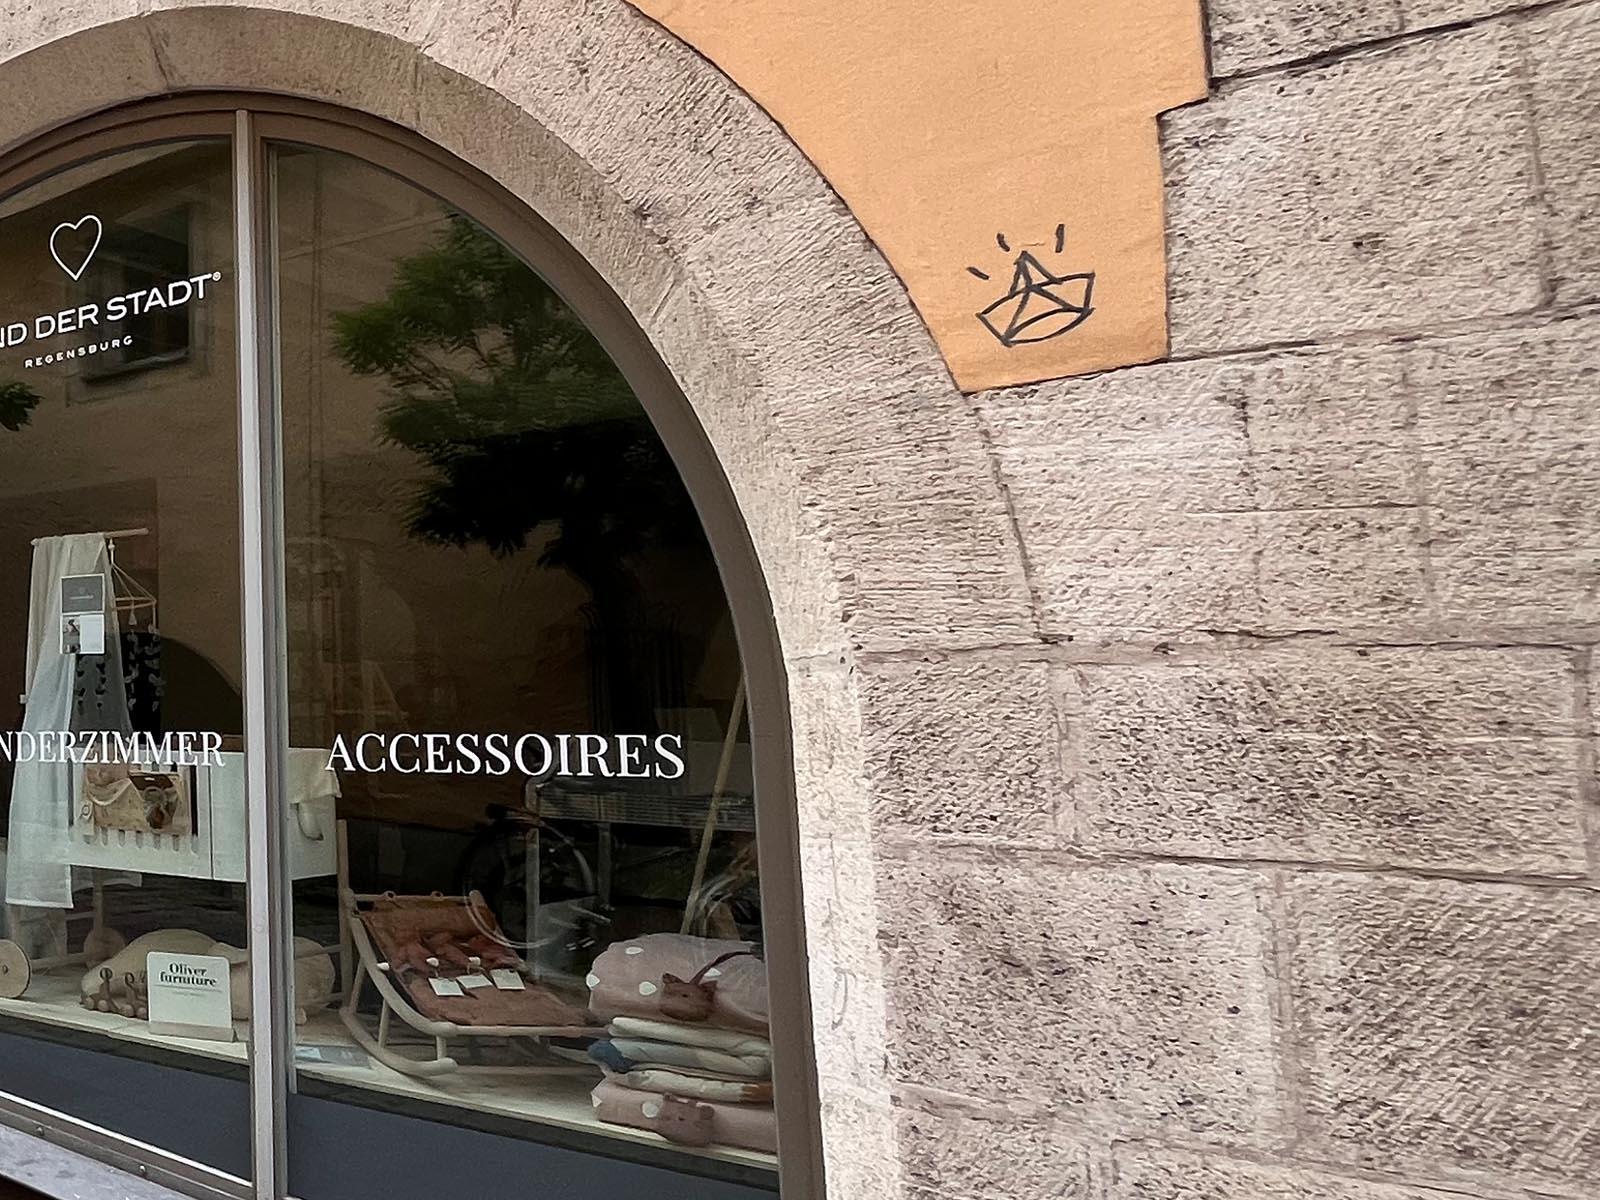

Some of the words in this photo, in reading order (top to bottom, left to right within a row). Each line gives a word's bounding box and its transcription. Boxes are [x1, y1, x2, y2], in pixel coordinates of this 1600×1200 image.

[35, 303, 99, 339] DER
[24, 335, 134, 369] REGENSBURG
[324, 732, 686, 780] ACCESSOIRES
[160, 971, 217, 987] furniture
[169, 962, 208, 977] Oliver
